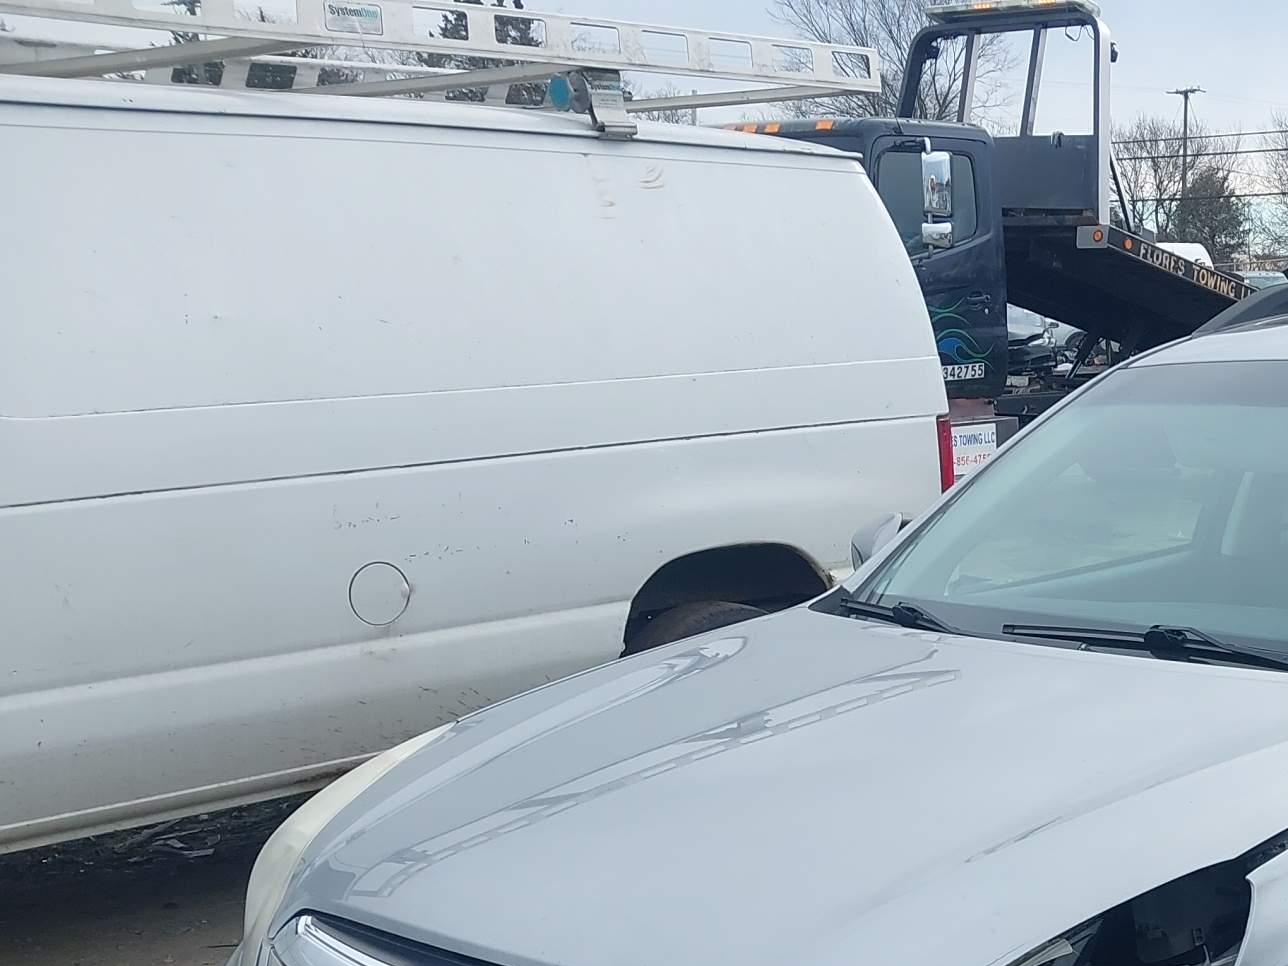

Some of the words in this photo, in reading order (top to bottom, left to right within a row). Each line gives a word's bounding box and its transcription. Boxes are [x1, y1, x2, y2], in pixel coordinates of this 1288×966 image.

[1192, 264, 1236, 297] TOWING
[959, 432, 983, 446] TOWING
[984, 431, 995, 444] LLC
